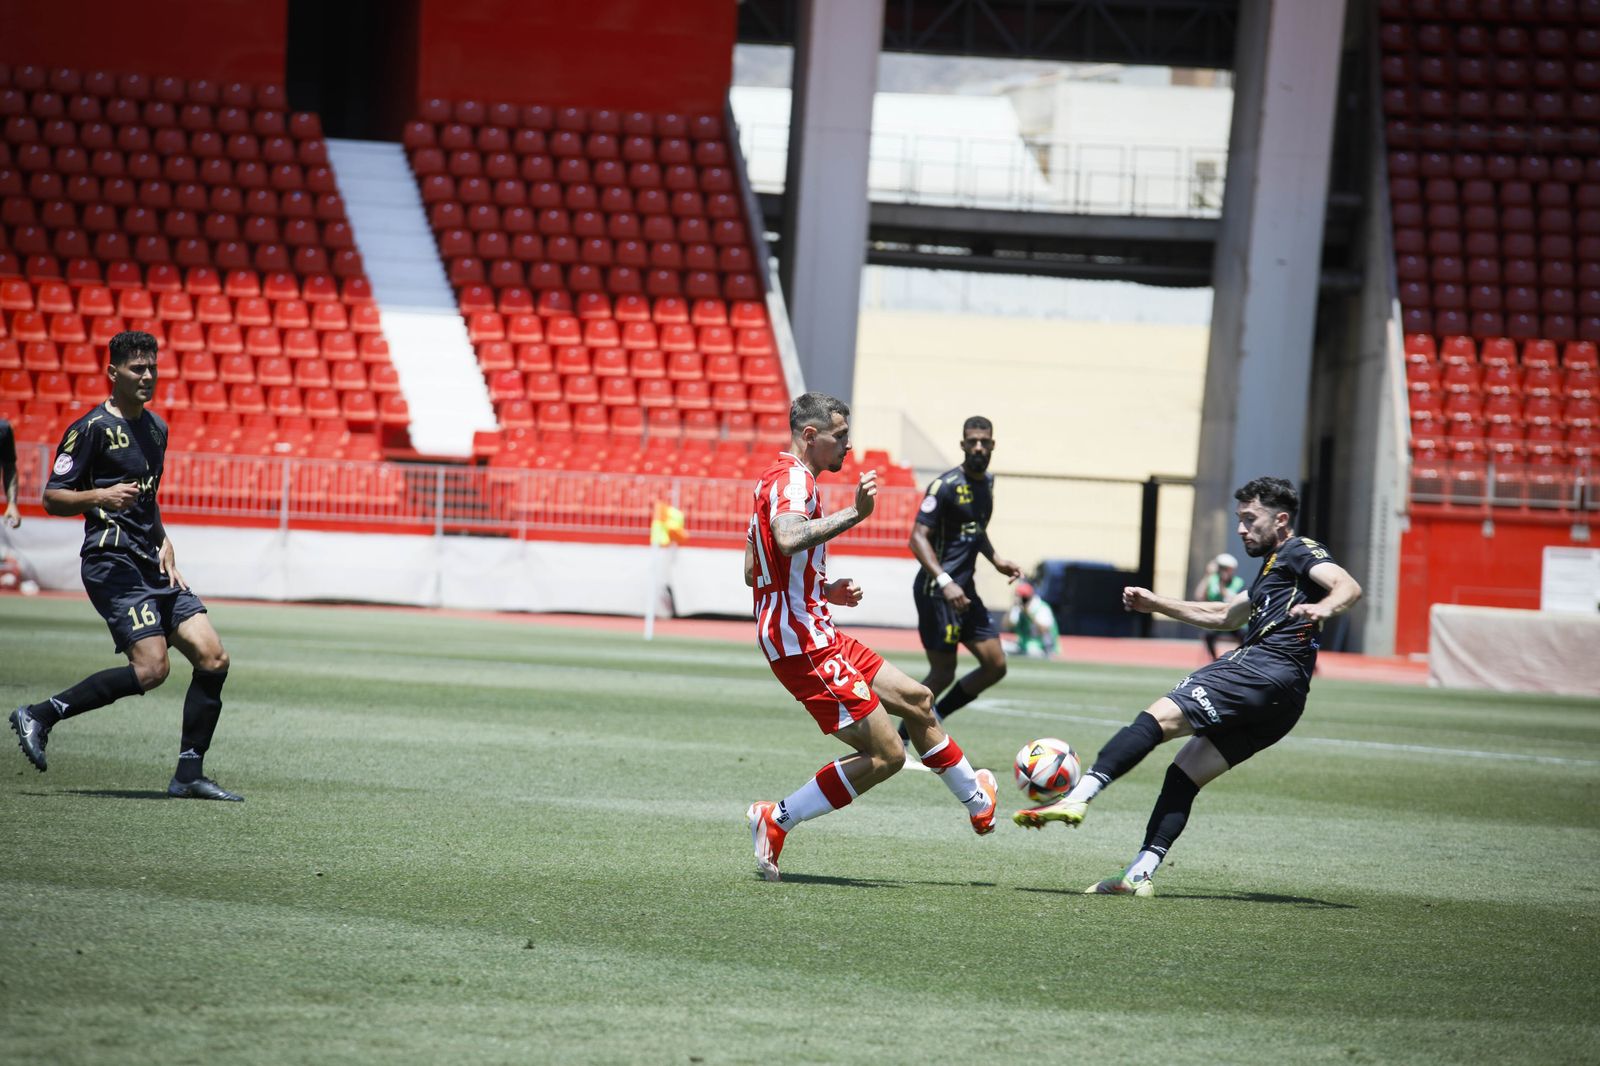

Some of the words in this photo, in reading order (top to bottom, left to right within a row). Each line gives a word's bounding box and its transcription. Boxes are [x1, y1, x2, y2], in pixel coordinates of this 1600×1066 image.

[105, 425, 130, 450] 16
[127, 603, 156, 631] 16
[823, 653, 859, 687] 21
